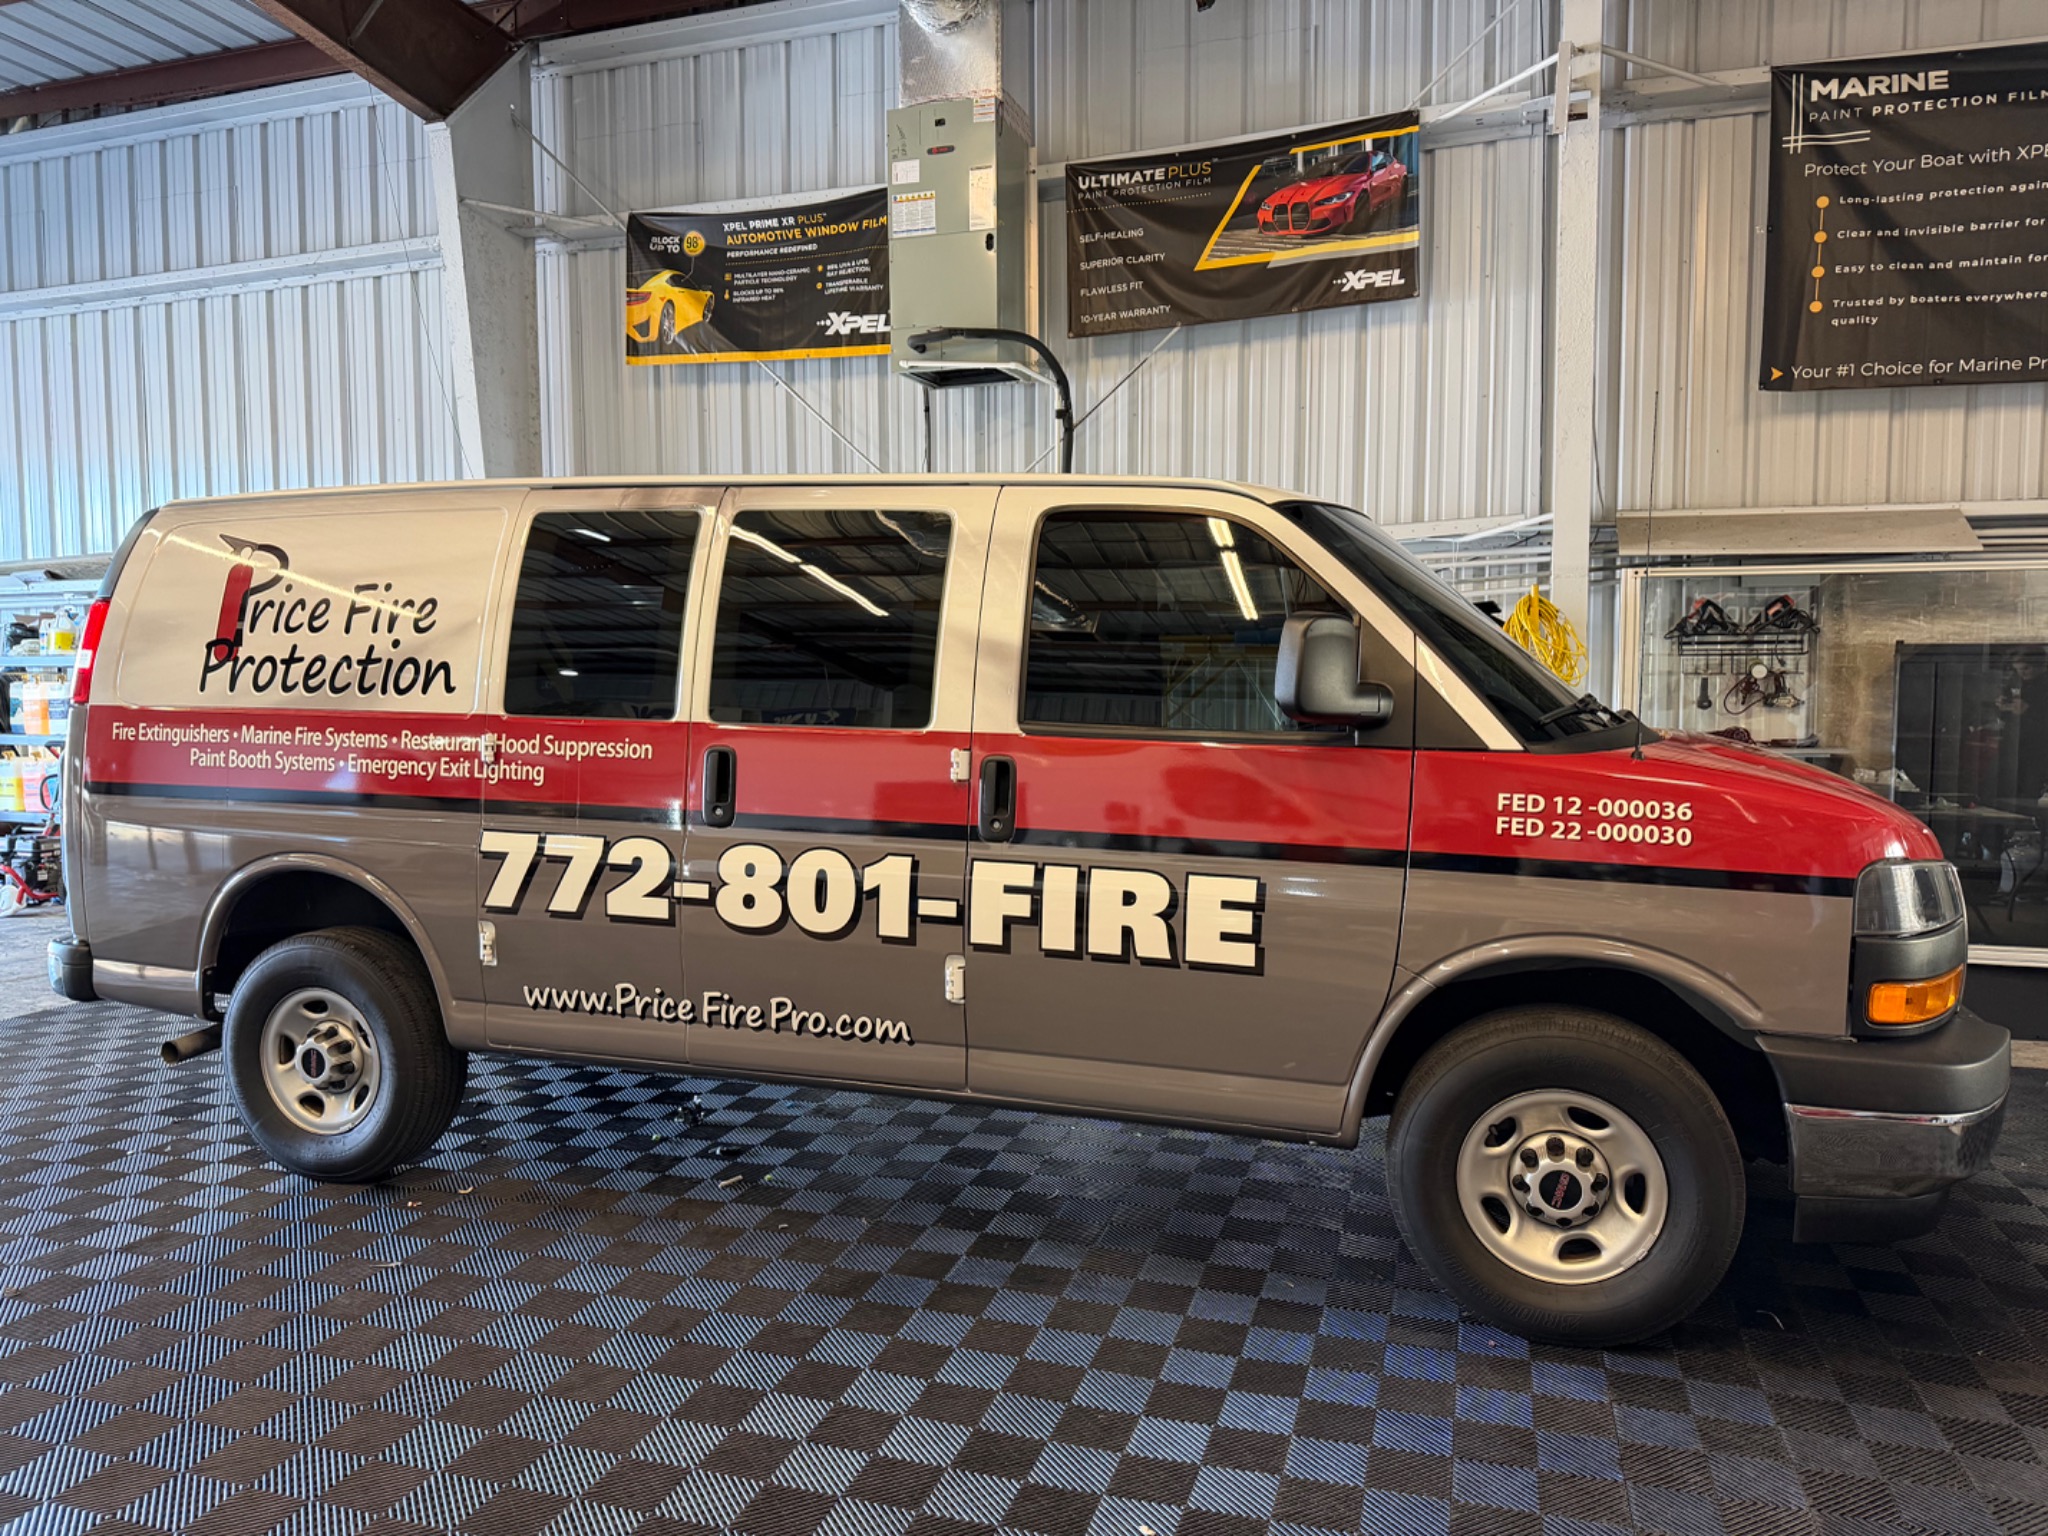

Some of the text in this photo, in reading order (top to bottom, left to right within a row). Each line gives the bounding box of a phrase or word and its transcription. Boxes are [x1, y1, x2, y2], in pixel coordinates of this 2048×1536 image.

[1811, 70, 1949, 102] MARINE
[1809, 107, 1863, 123] PAINT
[1872, 93, 1997, 117] PROTECTION
[1805, 161, 1867, 177] Protect
[1872, 156, 1915, 173] Your
[1921, 152, 1964, 168] Boat
[1969, 147, 2011, 164] with
[1078, 168, 1166, 190] ULTIMATE
[1078, 176, 1212, 200] PAINT PROTECTION FILM
[1840, 191, 1923, 206] Long-lasting
[1929, 184, 2005, 200] protection
[723, 220, 748, 232] XPEL
[749, 218, 779, 230] PRIME
[782, 216, 795, 226] XR
[726, 214, 888, 245] AUTOMOTIVE WINDOW FILM
[1837, 217, 2046, 239] Clear and invisible barrier for
[651, 235, 680, 245] BLOCK
[1079, 228, 1144, 244] SELF-HEALING
[649, 242, 665, 251] UP
[666, 244, 680, 254] TO
[727, 243, 818, 258] PERFORMANCE REDEFINED
[1079, 252, 1166, 271] SUPERIOR CLARITY
[1835, 264, 1865, 274] Easy
[1870, 262, 1884, 271] to
[1889, 260, 1924, 270] clean
[1929, 259, 1953, 269] and
[1959, 254, 2022, 267] maintain
[849, 284, 884, 292] WARRANTY
[1080, 280, 1144, 298] FLAWLESS FIT
[1340, 268, 1406, 292] XPEL
[1833, 290, 2048, 308] Trusted by boaters everywhere
[824, 311, 891, 336] XPEL
[1080, 305, 1171, 324] 10-YEAR WARRANTY
[1831, 315, 1878, 327] quality
[1791, 364, 1832, 379] Your
[1836, 363, 1855, 377] #1
[1861, 360, 1923, 377] Choice
[1928, 358, 1954, 374] for
[1959, 356, 2022, 373] Marine
[215, 536, 438, 647] Price Fire
[199, 637, 456, 696] Protection
[112, 722, 652, 761] Fire Extinguishers Marine Fire Systems Restauran Hood Suppression
[190, 748, 545, 786] Paint Booth Systems Emergency Exit Lighting
[1497, 793, 1693, 821] FED 12 -000036
[1496, 816, 1693, 847] FED 22 -000030
[479, 830, 1266, 976] 772-801-FIRE
